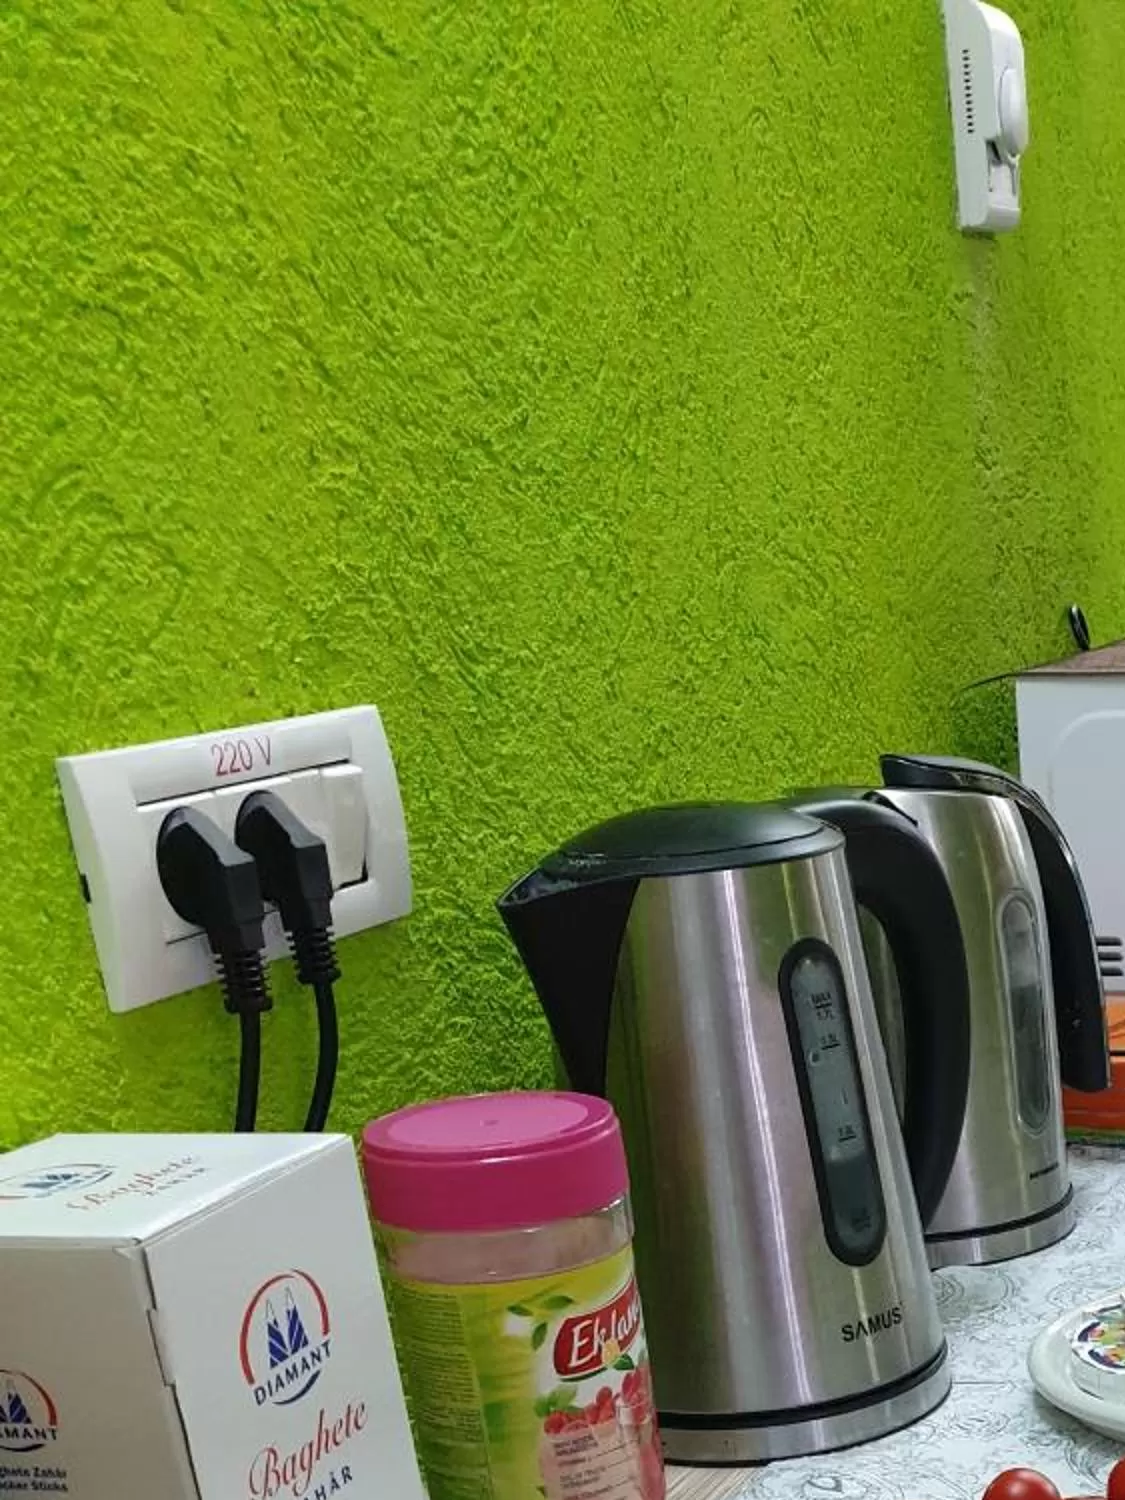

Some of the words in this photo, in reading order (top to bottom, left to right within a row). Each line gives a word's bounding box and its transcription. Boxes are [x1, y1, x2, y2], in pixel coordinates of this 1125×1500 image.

[211, 739, 253, 776] 220
[254, 735, 271, 766] V
[841, 1306, 902, 1342] SAMUS
[253, 1339, 331, 1406] DIAMANT
